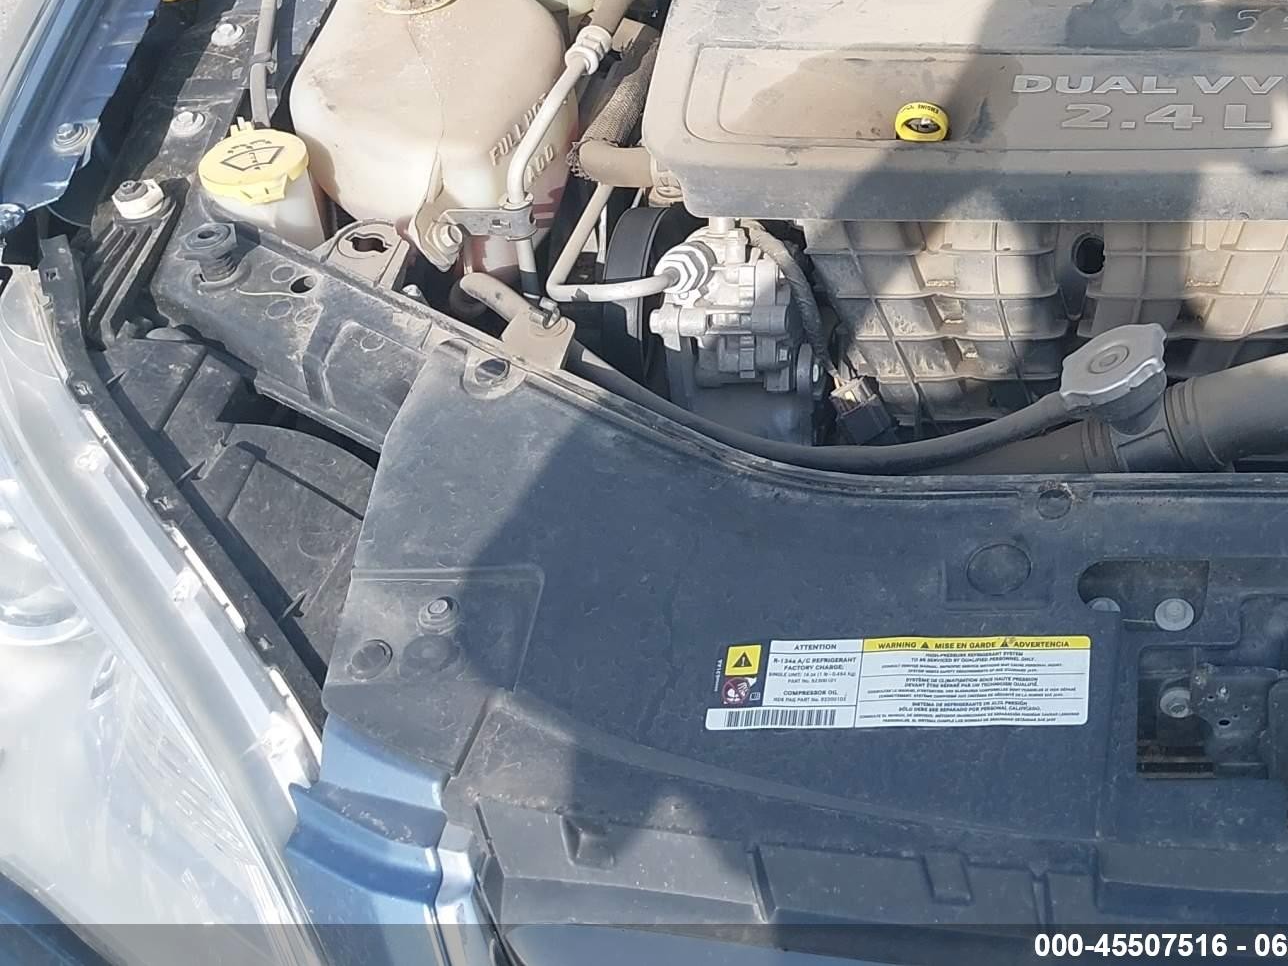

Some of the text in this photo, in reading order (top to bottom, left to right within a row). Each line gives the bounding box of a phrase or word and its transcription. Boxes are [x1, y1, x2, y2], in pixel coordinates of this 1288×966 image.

[1012, 75, 1178, 95] DUAL
[488, 123, 526, 167] FULL
[526, 144, 555, 183] ADD
[794, 643, 837, 651] ATTENTION
[878, 641, 917, 649] WARNING
[969, 641, 997, 649] GARDE
